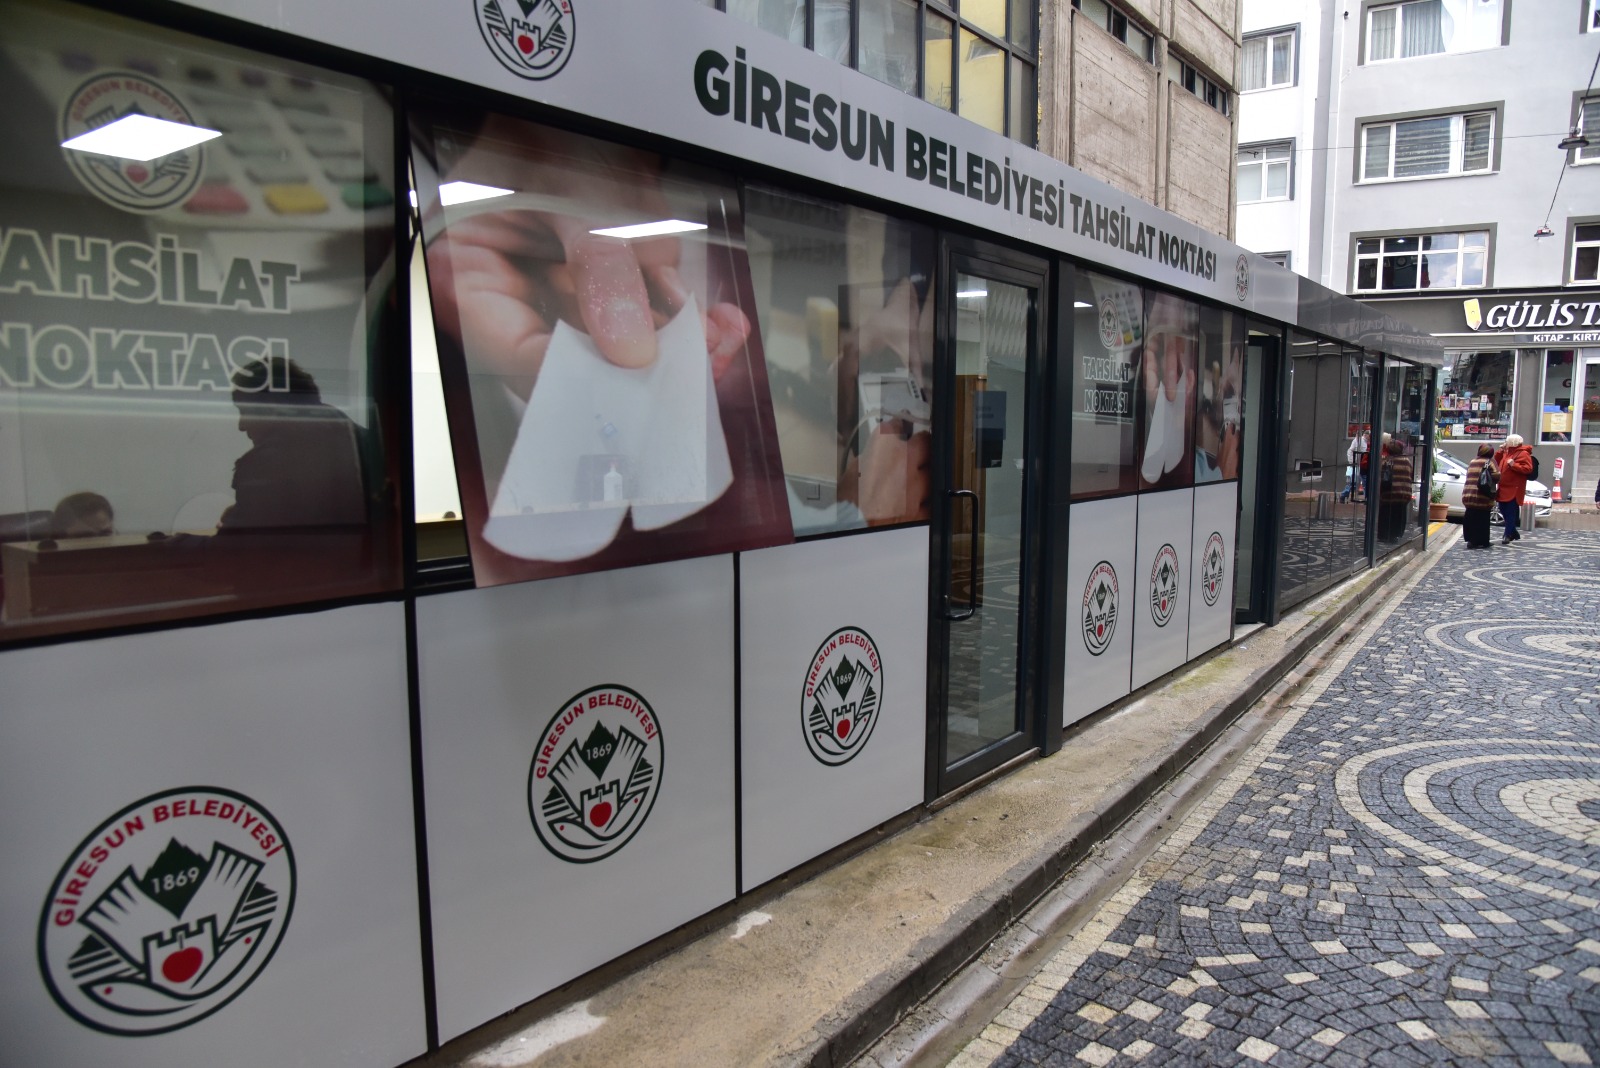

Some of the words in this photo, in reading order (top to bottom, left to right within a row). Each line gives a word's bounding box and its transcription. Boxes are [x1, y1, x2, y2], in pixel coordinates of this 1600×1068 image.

[694, 45, 894, 172] GİRESUN
[906, 128, 1064, 228] BELEDİYESİ
[1070, 193, 1156, 259] TAHSİLAT
[1158, 229, 1217, 282] NOKTASI
[0, 228, 300, 313] AHSİLAT
[1083, 355, 1131, 383] TAHSİLAT
[1084, 389, 1128, 413] NOKTASI
[806, 640, 837, 698] GİRESUN
[838, 633, 880, 673] BELEDİYESİ
[836, 672, 853, 686] 1869
[536, 703, 585, 779] GİRESUN
[588, 693, 658, 740] BELEDİYESİ
[586, 743, 612, 761] 1869
[54, 816, 145, 927] GİRESUN
[152, 799, 284, 858] BELEDİYESİ
[152, 867, 200, 894] 1869
